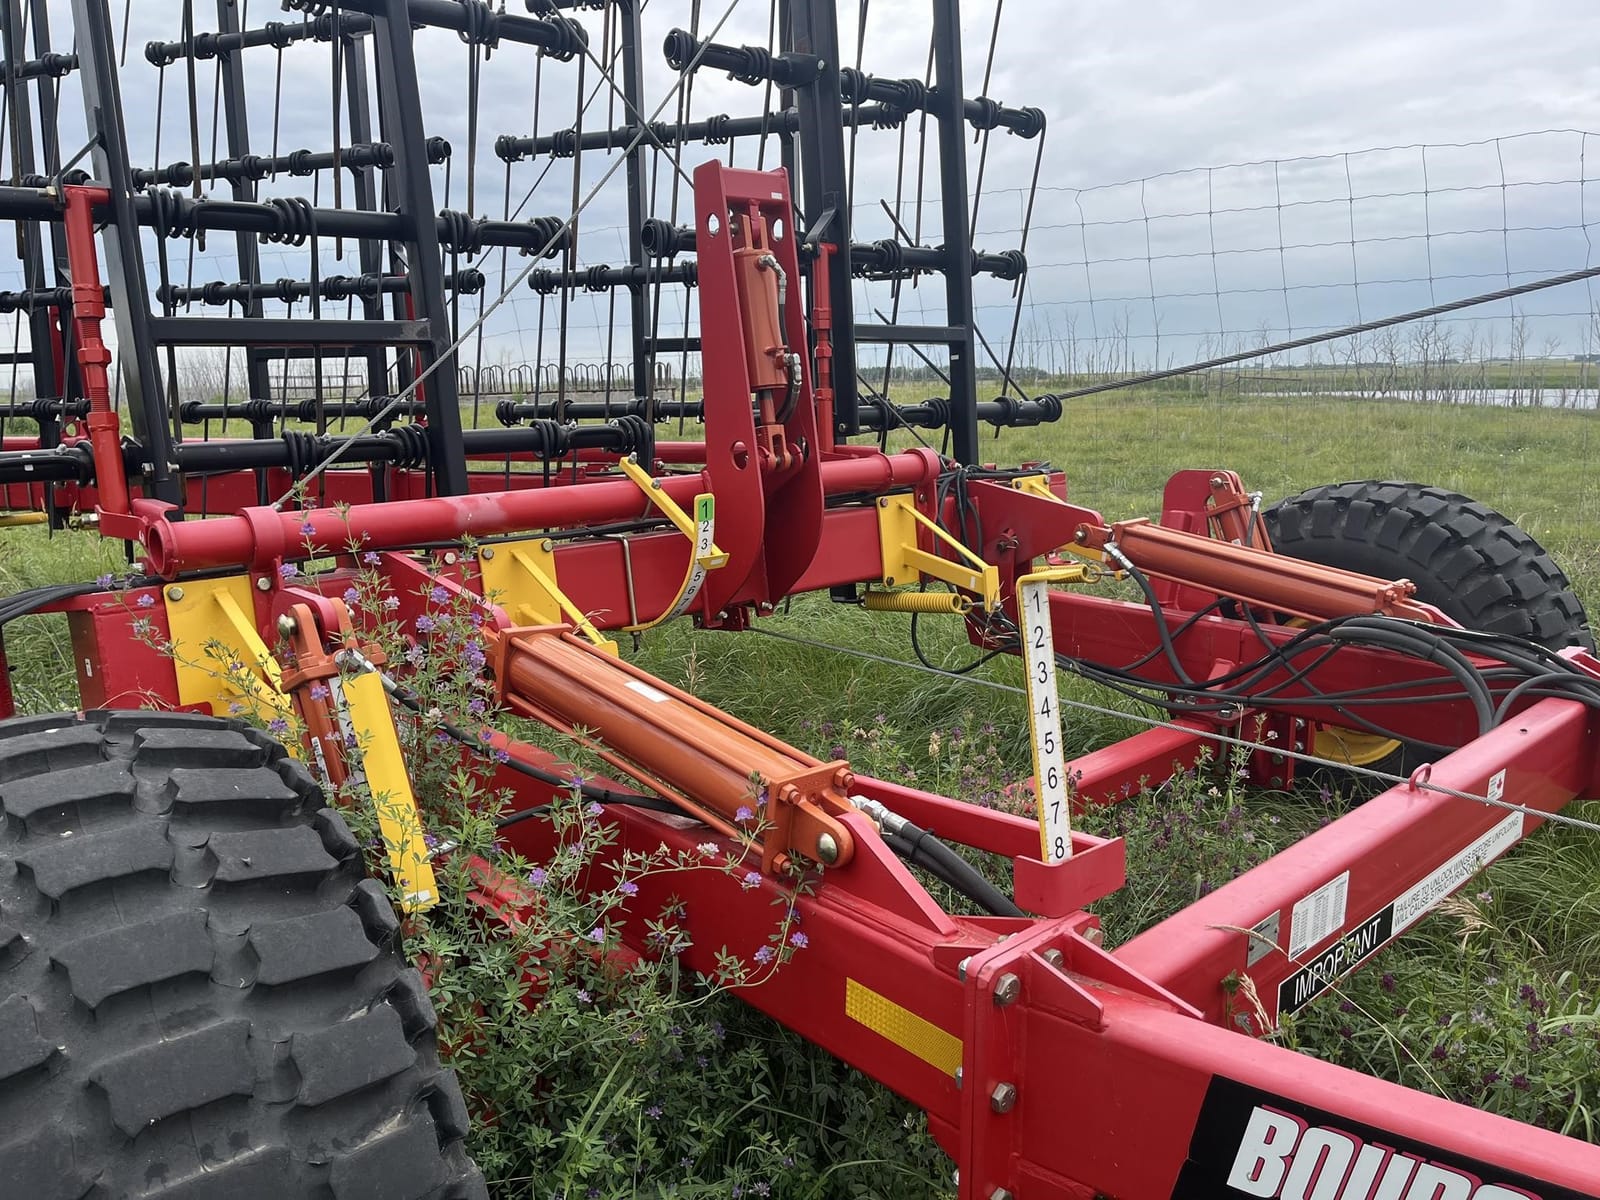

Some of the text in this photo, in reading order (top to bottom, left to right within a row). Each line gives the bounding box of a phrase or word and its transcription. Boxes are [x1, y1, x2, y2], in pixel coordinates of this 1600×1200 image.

[701, 500, 709, 519] 1
[702, 520, 710, 533] 2
[701, 538, 708, 550] 3
[693, 571, 702, 582] 5
[687, 585, 696, 595] 6
[1032, 590, 1041, 613] 1
[1033, 625, 1045, 649] 2
[1037, 661, 1048, 684] 3
[1040, 696, 1051, 719] 4
[1044, 731, 1055, 755] 5
[1047, 766, 1058, 790] 6
[1050, 800, 1060, 825] 7
[1054, 836, 1065, 859] 8
[1395, 889, 1421, 915] FAILURE
[1421, 883, 1430, 897] TO
[1430, 867, 1454, 891] UNLOCK
[1471, 837, 1492, 860] BEFORE
[1491, 815, 1519, 845] UNFOLDING
[1394, 909, 1409, 928] WILL
[1409, 893, 1431, 917] CAUSE
[1430, 867, 1466, 901] STRUCTURAL
[1294, 917, 1381, 1006] IMPORTANT
